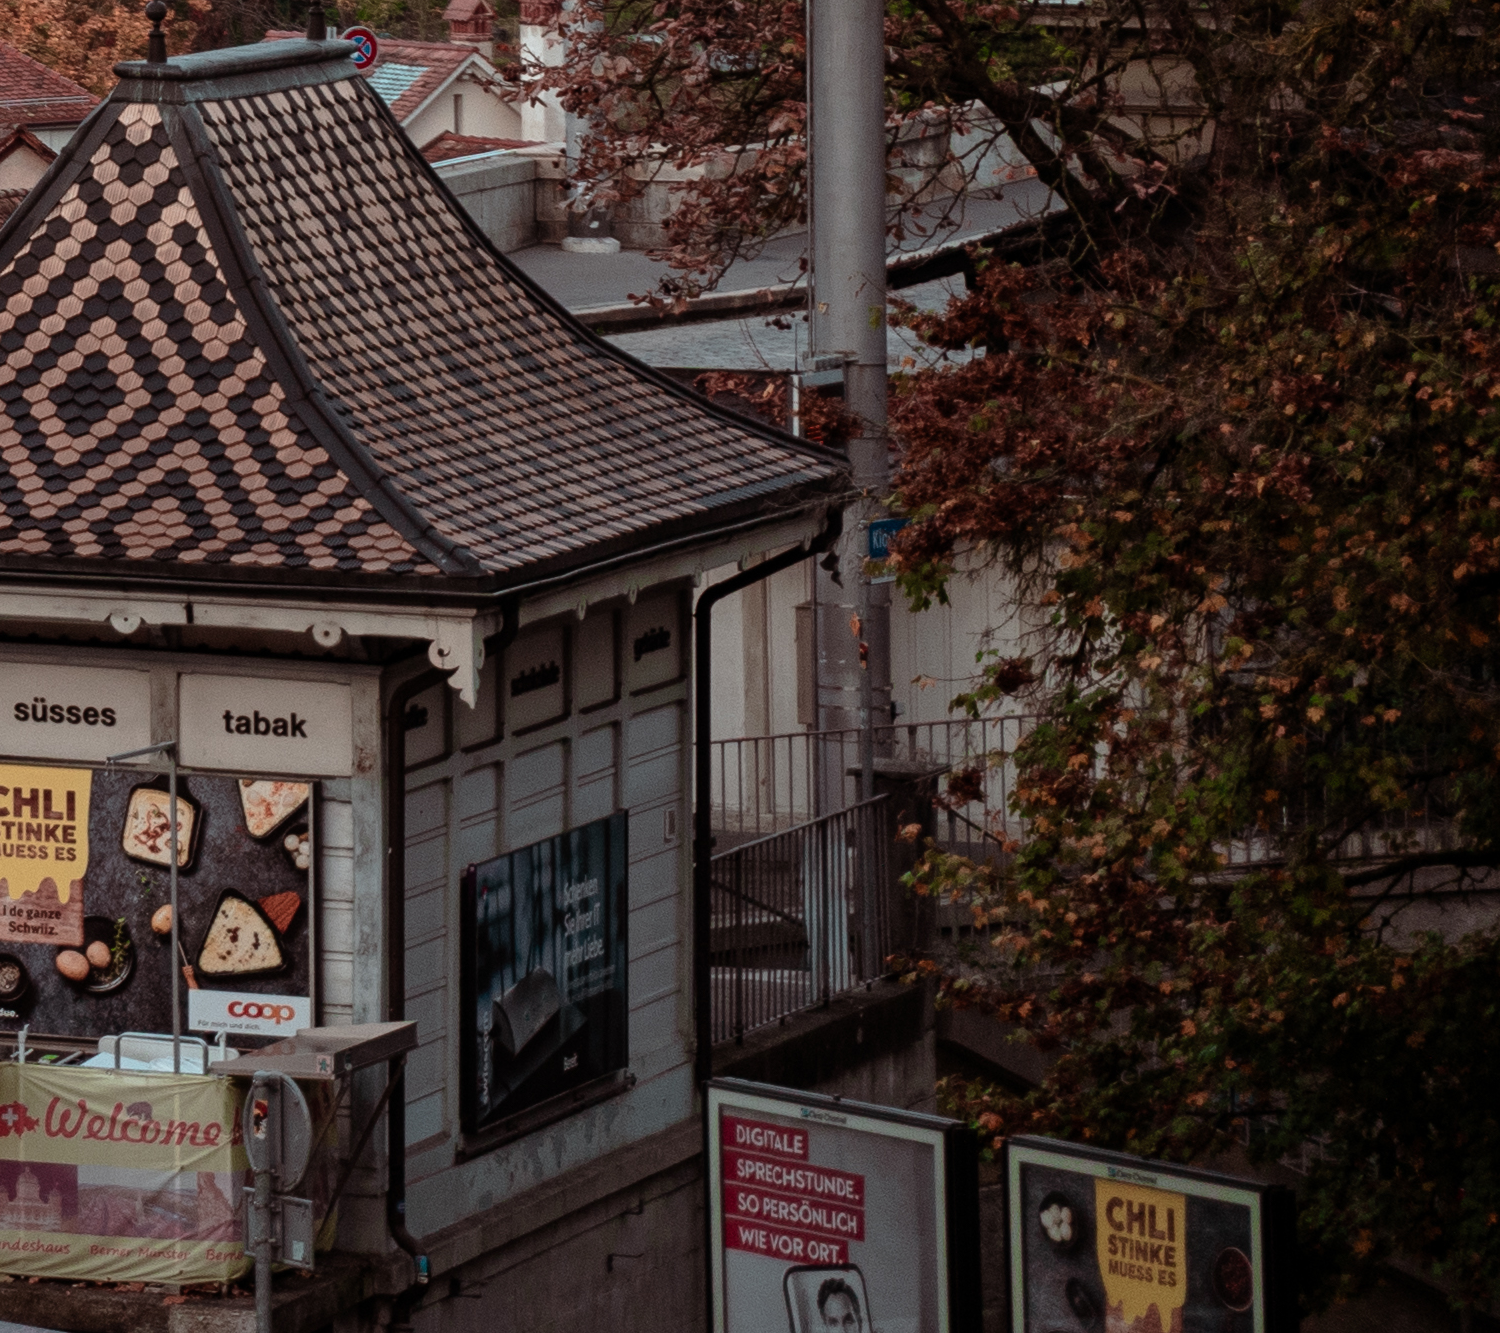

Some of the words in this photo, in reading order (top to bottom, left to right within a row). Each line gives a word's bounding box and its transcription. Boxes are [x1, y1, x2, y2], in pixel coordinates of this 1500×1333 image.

[12, 696, 117, 728] süsses
[222, 708, 306, 739] tabak
[55, 846, 77, 862] ES
[8, 920, 59, 936] Schwiiz.
[9, 906, 24, 918] de
[25, 909, 63, 921] ganze
[227, 1000, 296, 1025] coop
[43, 1096, 223, 1147] Welcome
[735, 1124, 804, 1156] DIGITALE
[736, 1158, 861, 1201] SPRECHSTUNDE.
[738, 1192, 760, 1215] SO
[763, 1197, 859, 1235] PERSÖNLICH
[1105, 1196, 1176, 1243] CHLI
[738, 1225, 768, 1251] WIE
[769, 1232, 804, 1258] VOR
[806, 1240, 845, 1266] ORT.
[1107, 1233, 1178, 1268] STINKE
[1107, 1259, 1154, 1284] MUESS
[1157, 1268, 1178, 1288] ES
